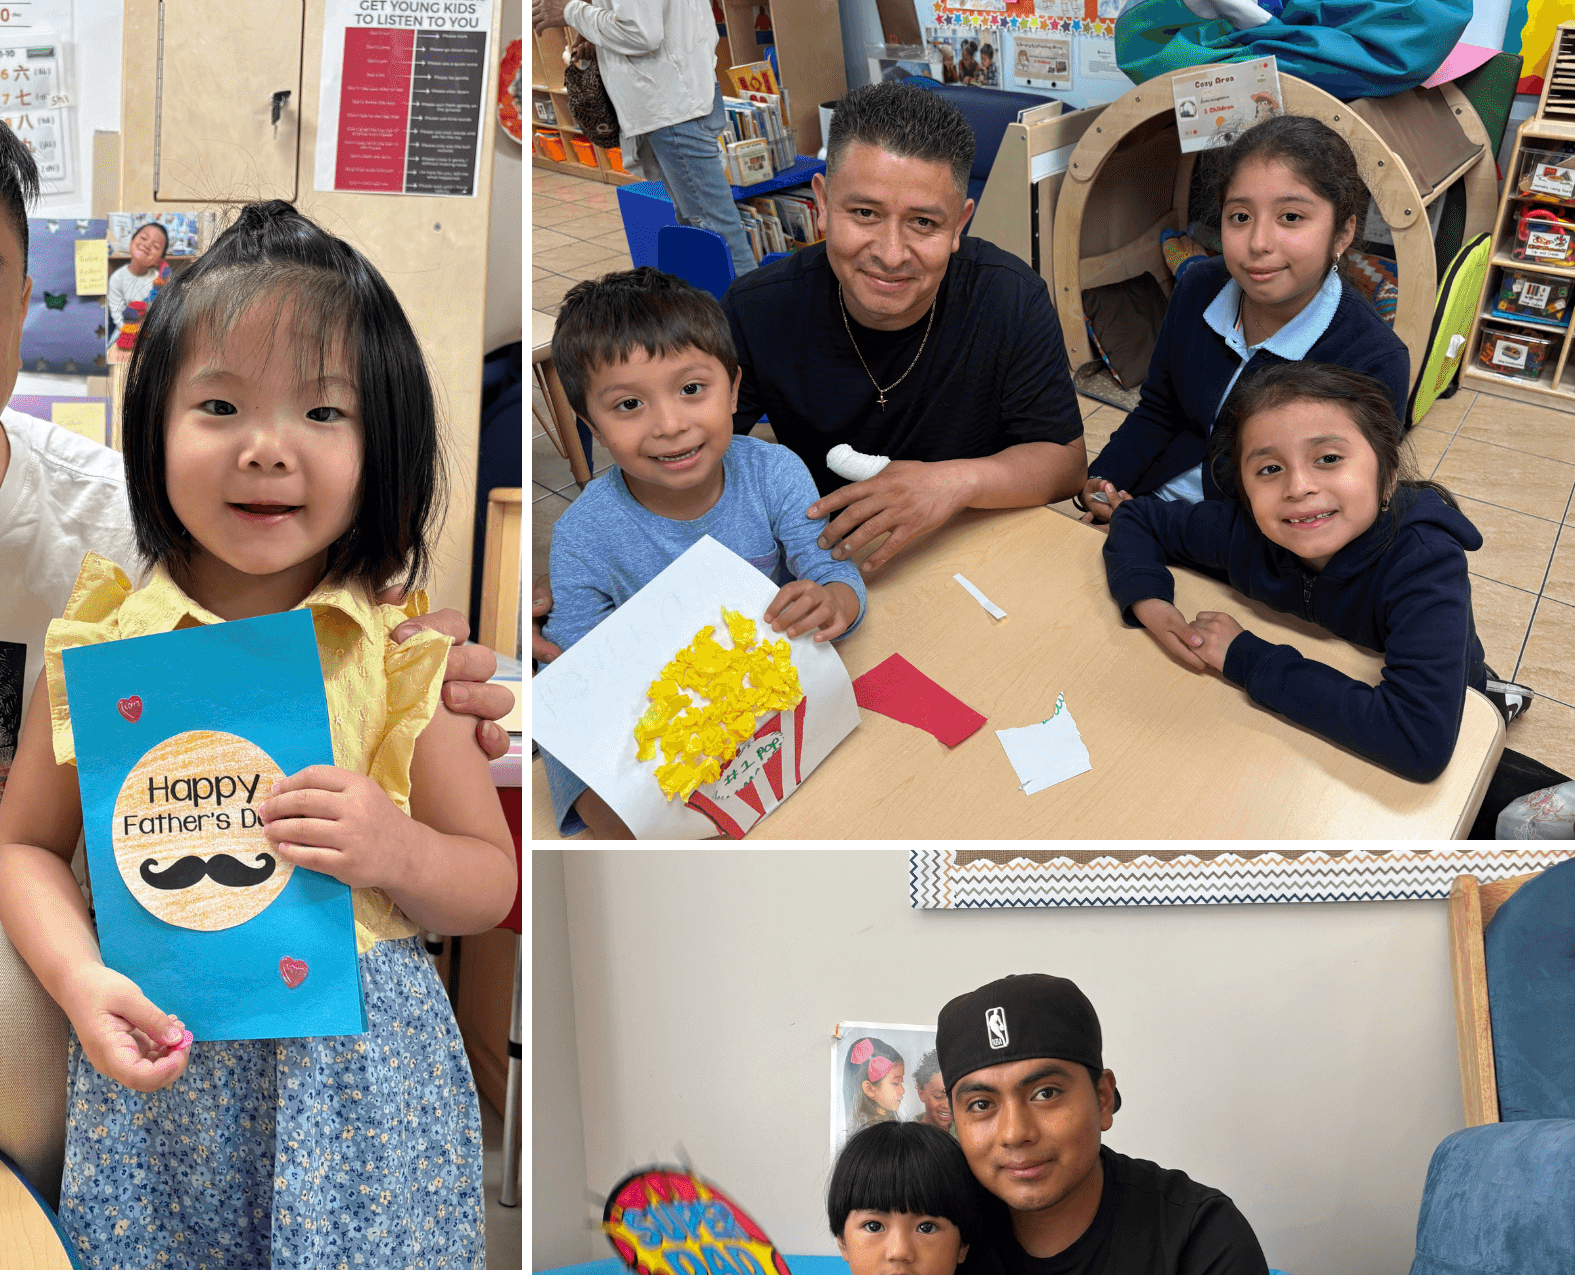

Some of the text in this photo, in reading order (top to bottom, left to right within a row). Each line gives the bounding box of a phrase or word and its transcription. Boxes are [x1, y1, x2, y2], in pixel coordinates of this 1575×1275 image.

[359, 0, 477, 14] GET YOUNG KIDS
[355, 13, 479, 28] TO LISTEN TO YOU
[0, 50, 15, 58] 1-10
[0, 69, 9, 80] 6
[13, 65, 30, 82] 六
[1195, 76, 1235, 89] Cozy Area
[2, 93, 10, 105] 7
[15, 89, 31, 107] 七
[17, 114, 34, 130] 八
[148, 773, 261, 808] Happy
[124, 809, 231, 836] Father's
